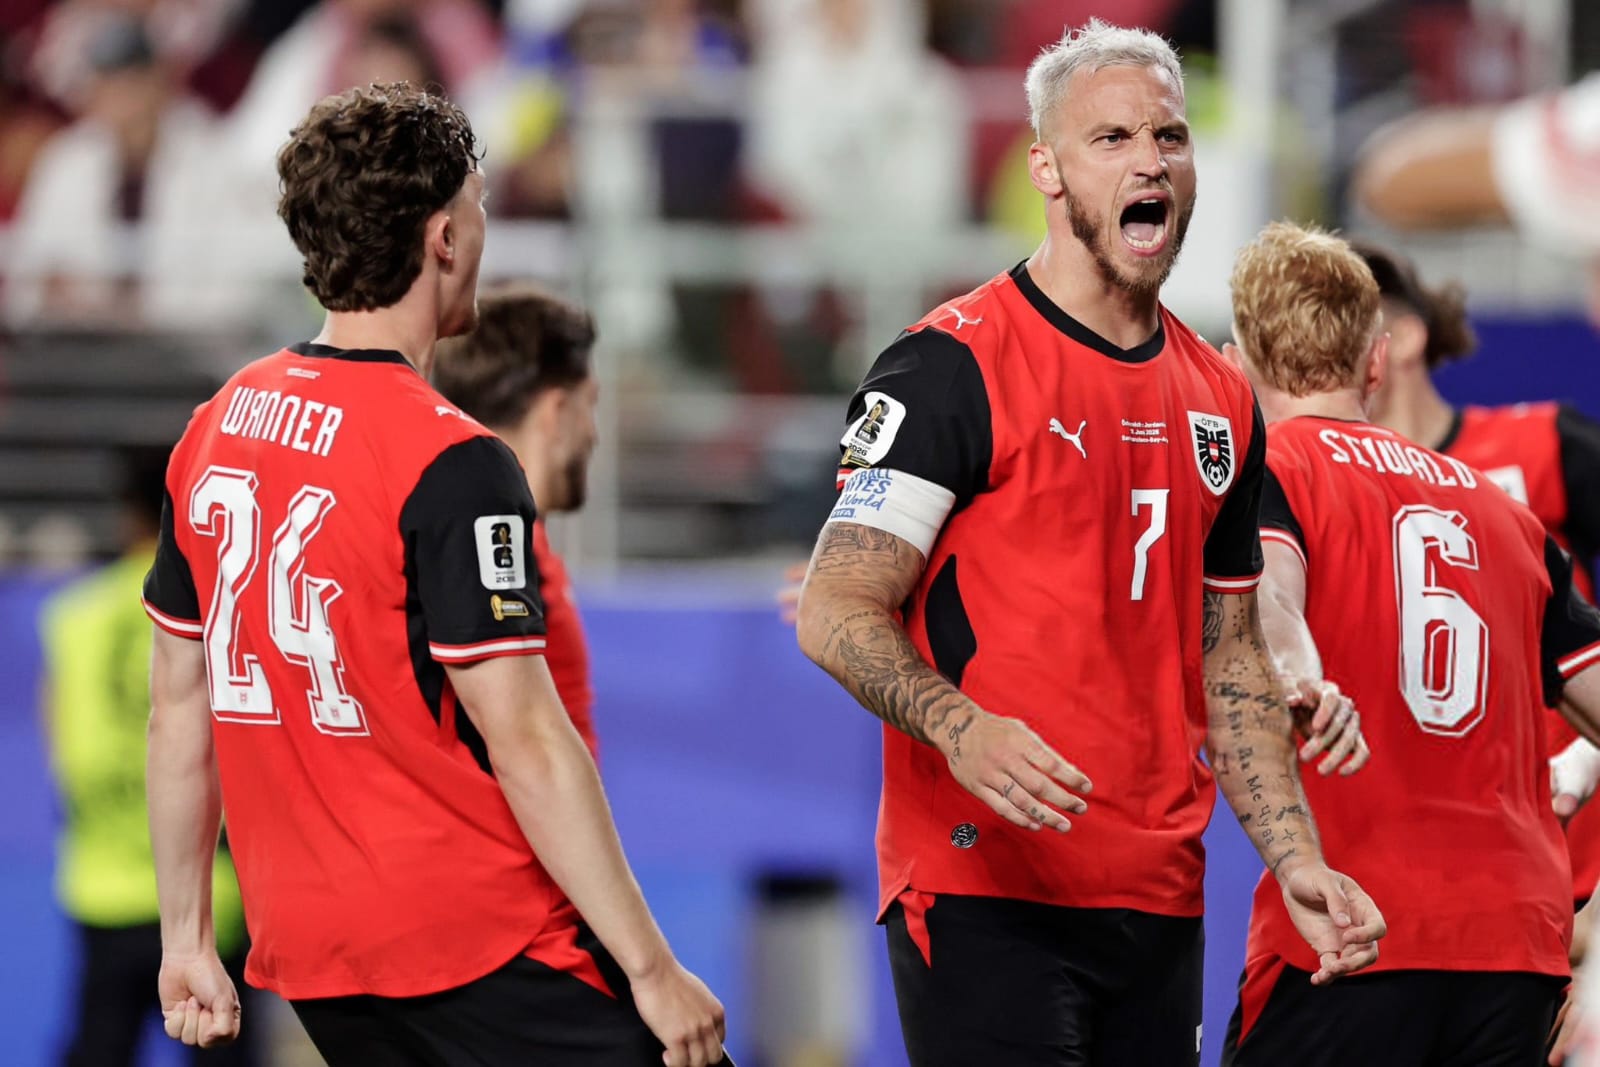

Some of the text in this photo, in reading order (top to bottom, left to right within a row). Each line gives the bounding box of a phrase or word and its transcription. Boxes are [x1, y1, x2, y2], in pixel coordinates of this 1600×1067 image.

[220, 386, 343, 457] WANNER
[848, 442, 867, 457] 2026
[1201, 416, 1219, 428] ÖFB
[1319, 429, 1477, 489] STIWALD
[840, 493, 886, 511] World
[1131, 488, 1170, 601] 7
[189, 464, 370, 737] 24
[1393, 504, 1489, 737] 6
